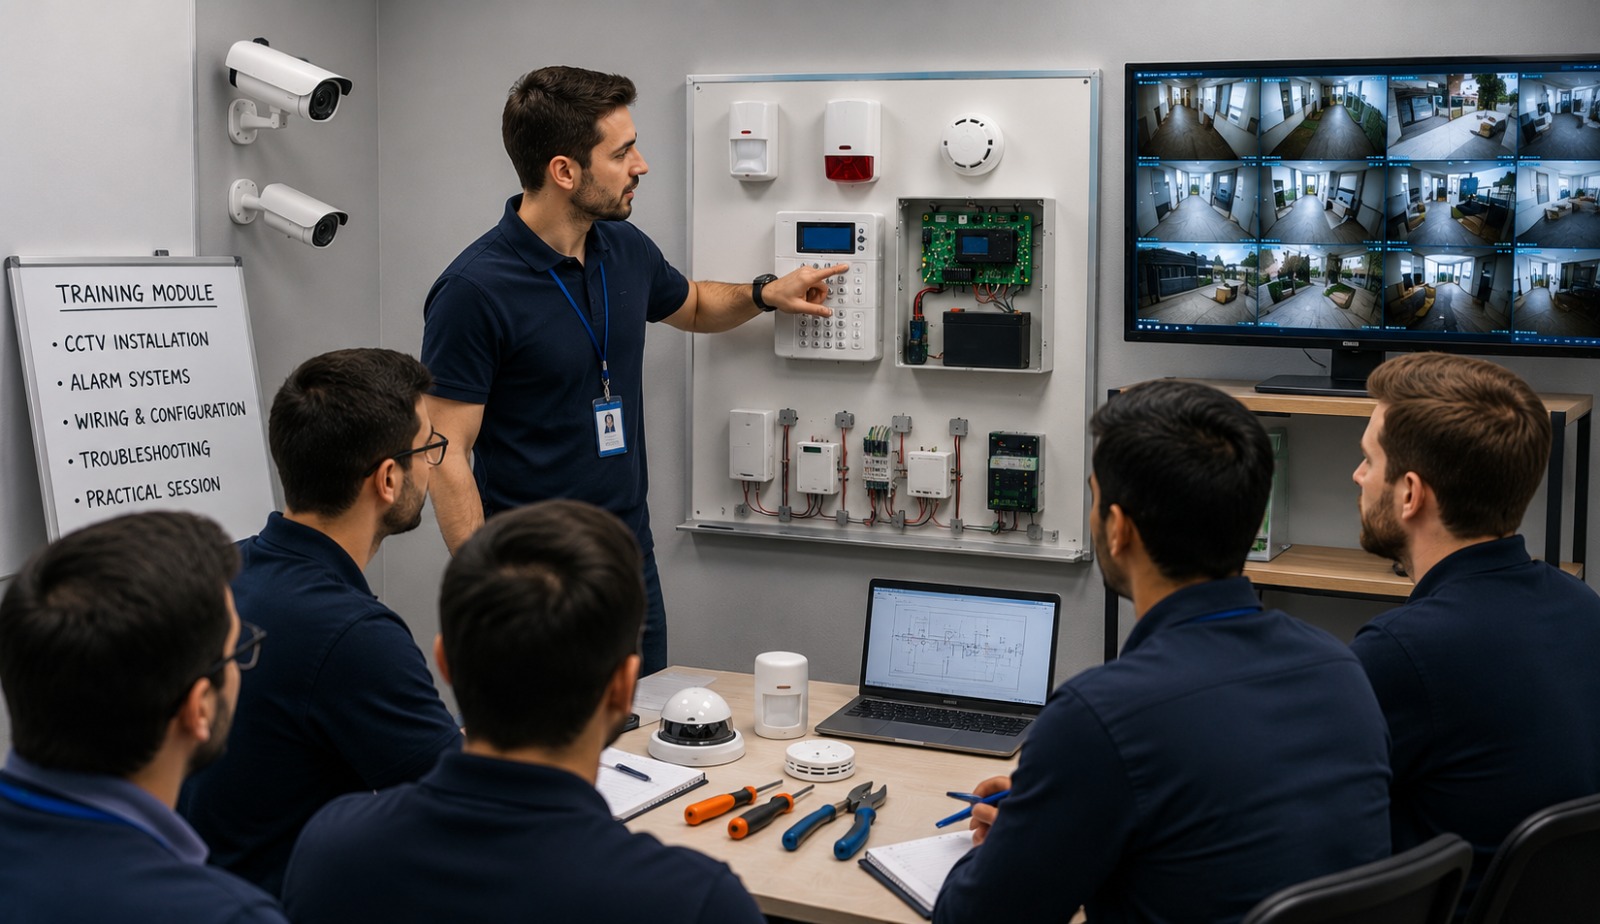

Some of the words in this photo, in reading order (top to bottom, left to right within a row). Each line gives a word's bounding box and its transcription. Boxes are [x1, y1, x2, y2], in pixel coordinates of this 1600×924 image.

[55, 284, 144, 303] TRAINING
[153, 284, 214, 301] MODULE
[65, 335, 105, 352] CCTV
[114, 332, 209, 349] INSTALLATION
[71, 373, 122, 391] ALARM
[129, 369, 190, 387] SYSTEMS
[75, 410, 128, 429] WIRING
[136, 408, 145, 424] &
[151, 401, 246, 423] CONFIGURATION
[79, 440, 210, 468] TROUBLESHOOTING
[86, 484, 162, 508] PRACTICAL
[167, 476, 220, 497] SESSION
